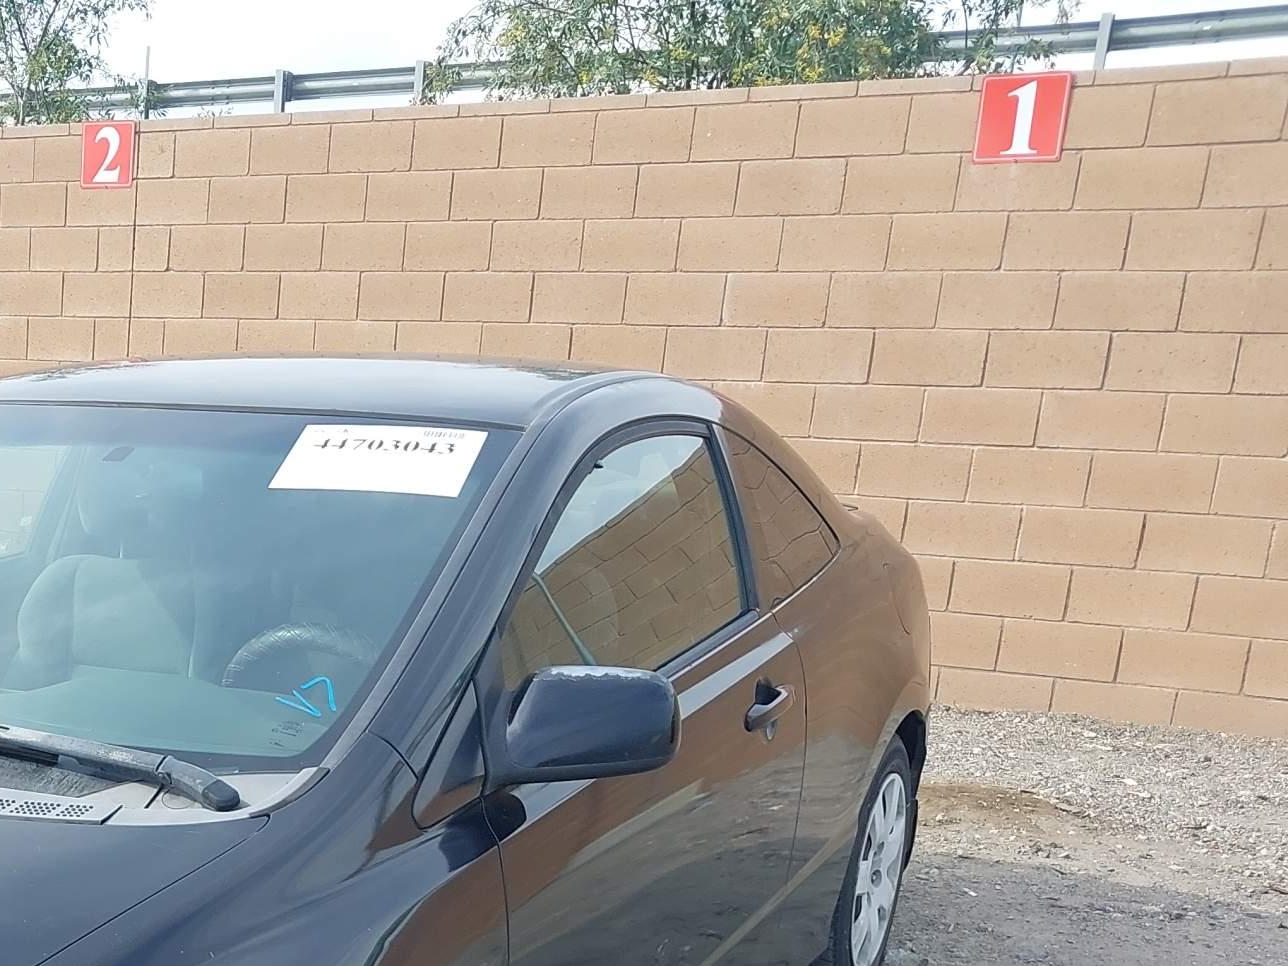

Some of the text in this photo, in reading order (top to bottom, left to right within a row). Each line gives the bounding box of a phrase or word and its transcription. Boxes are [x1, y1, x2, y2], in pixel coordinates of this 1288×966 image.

[1001, 79, 1039, 156] 1
[93, 126, 121, 183] 2
[314, 438, 455, 454] 44703043
